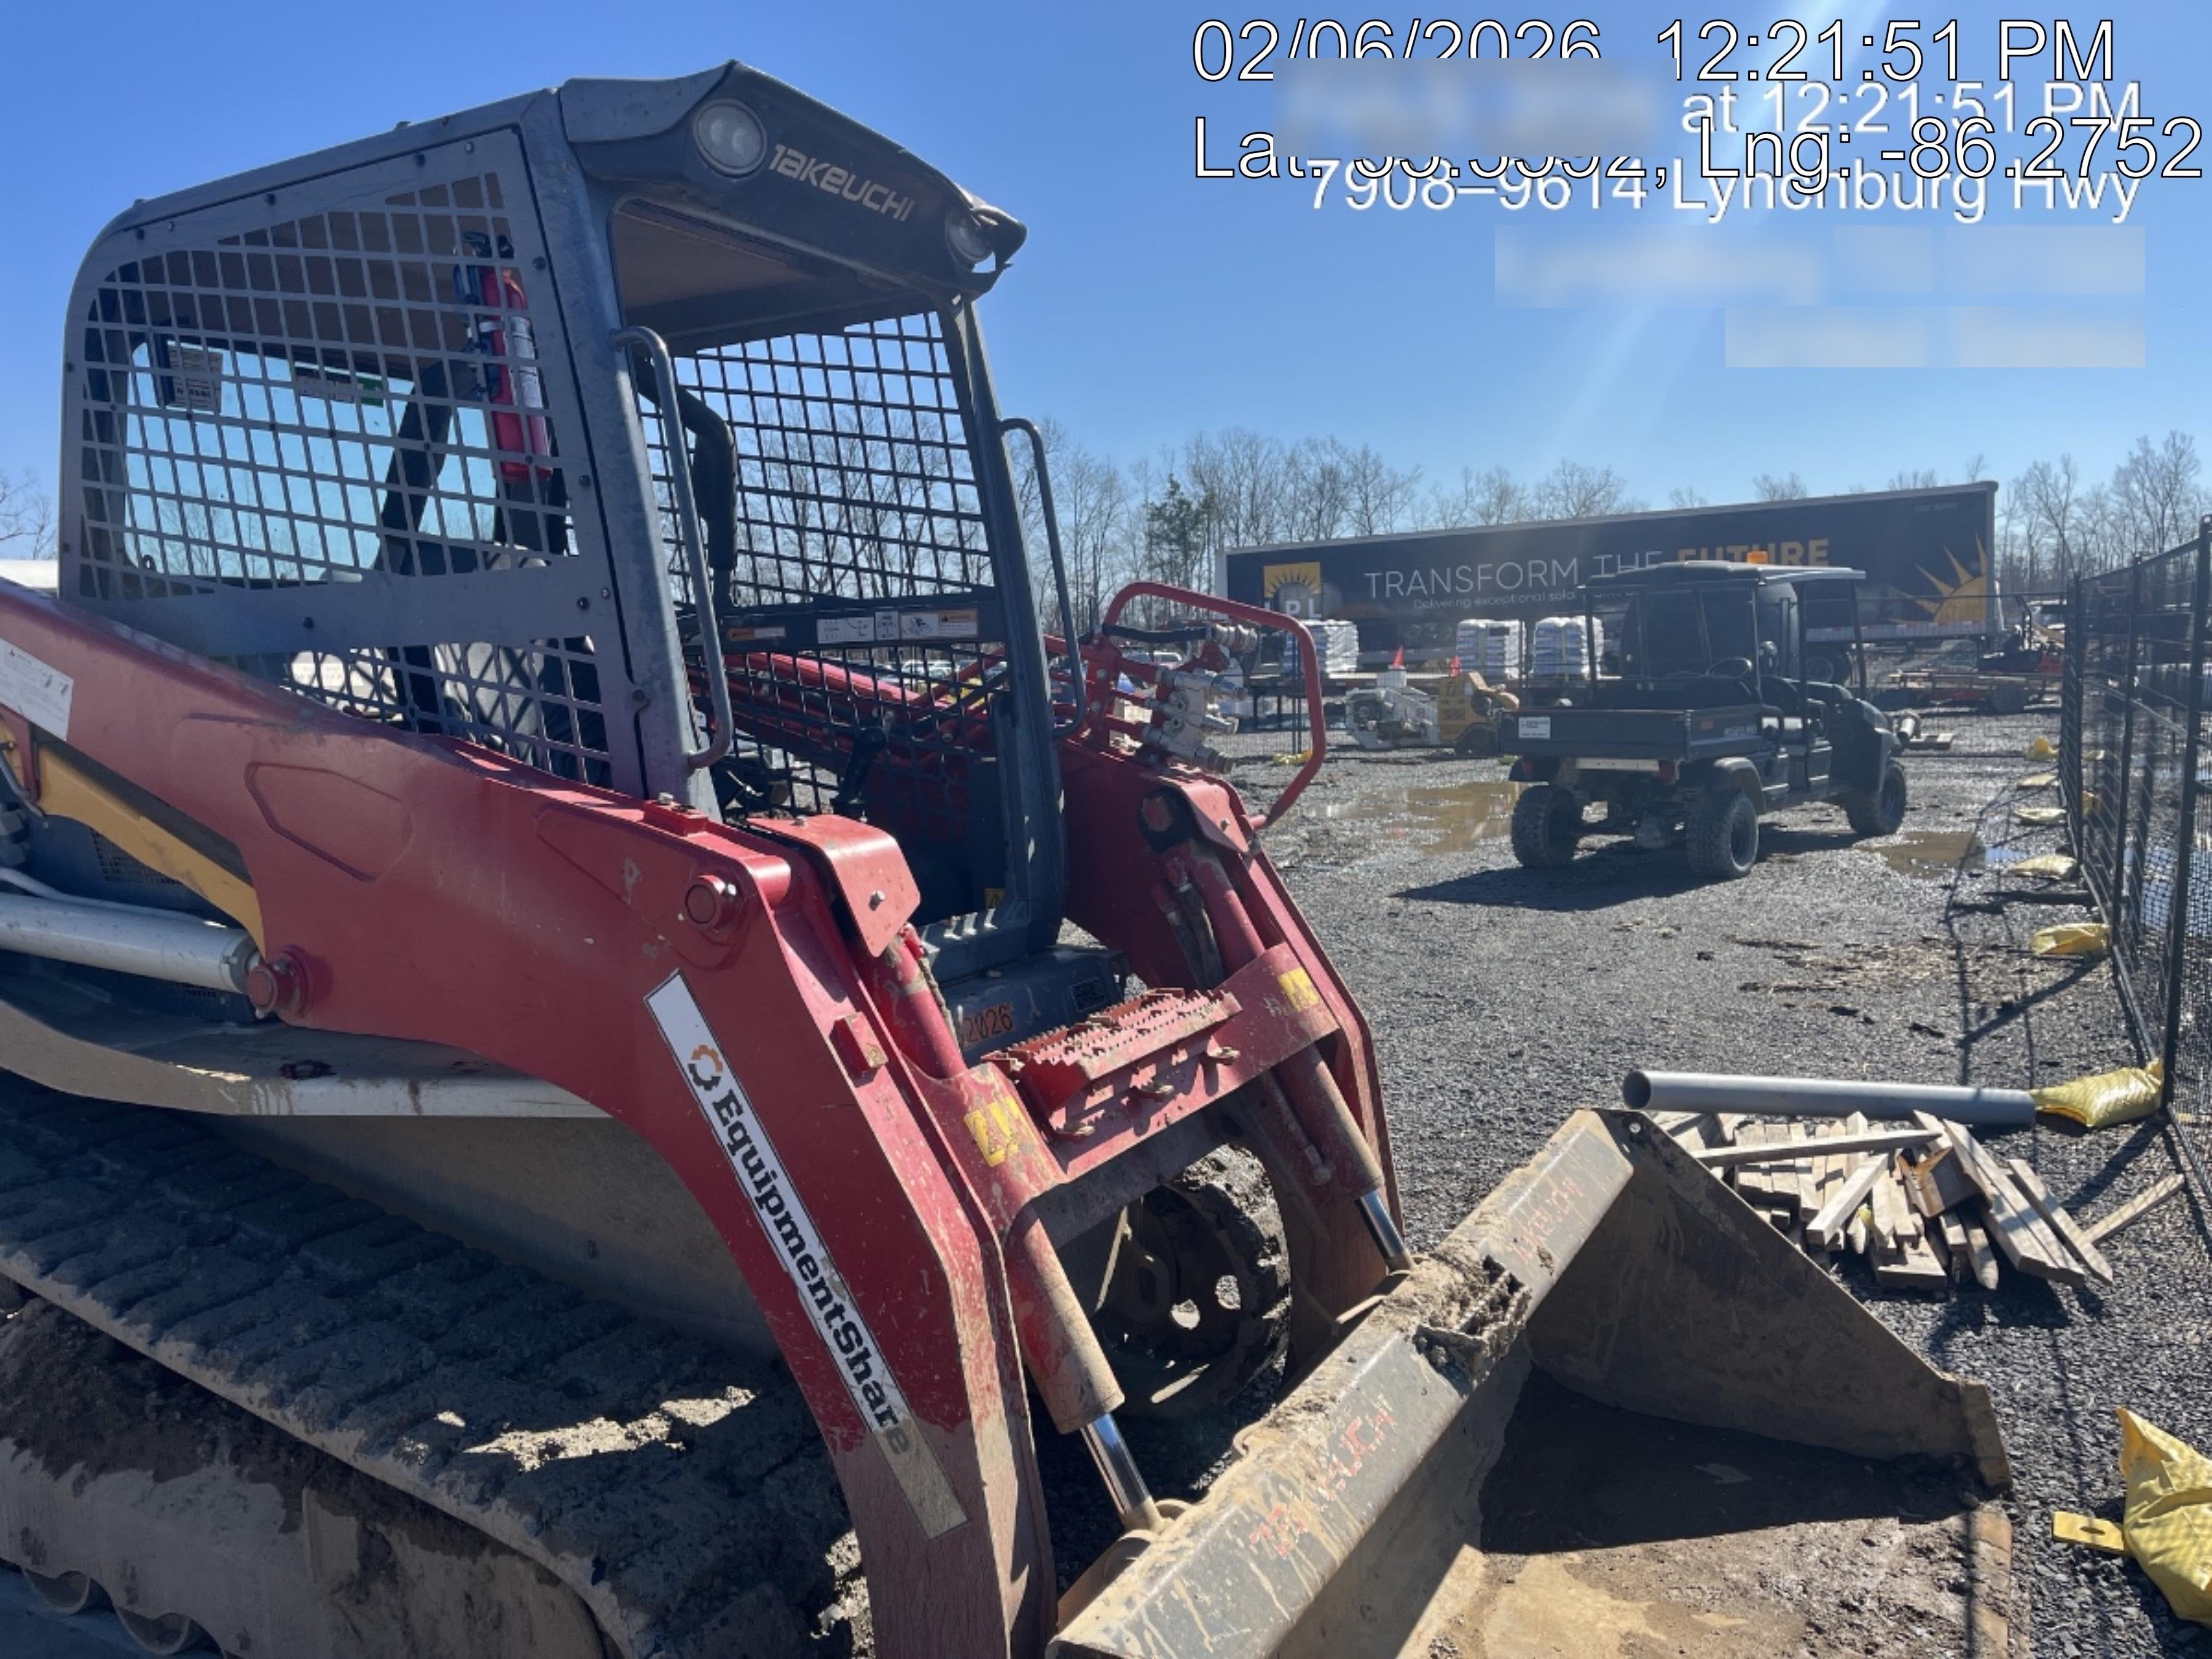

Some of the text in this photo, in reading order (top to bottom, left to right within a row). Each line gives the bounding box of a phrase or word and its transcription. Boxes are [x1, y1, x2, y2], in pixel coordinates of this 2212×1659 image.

[1364, 557, 1579, 599] TRANSFORM
[1549, 589, 1577, 602] sola
[712, 1089, 909, 1456] EquipmentShare
